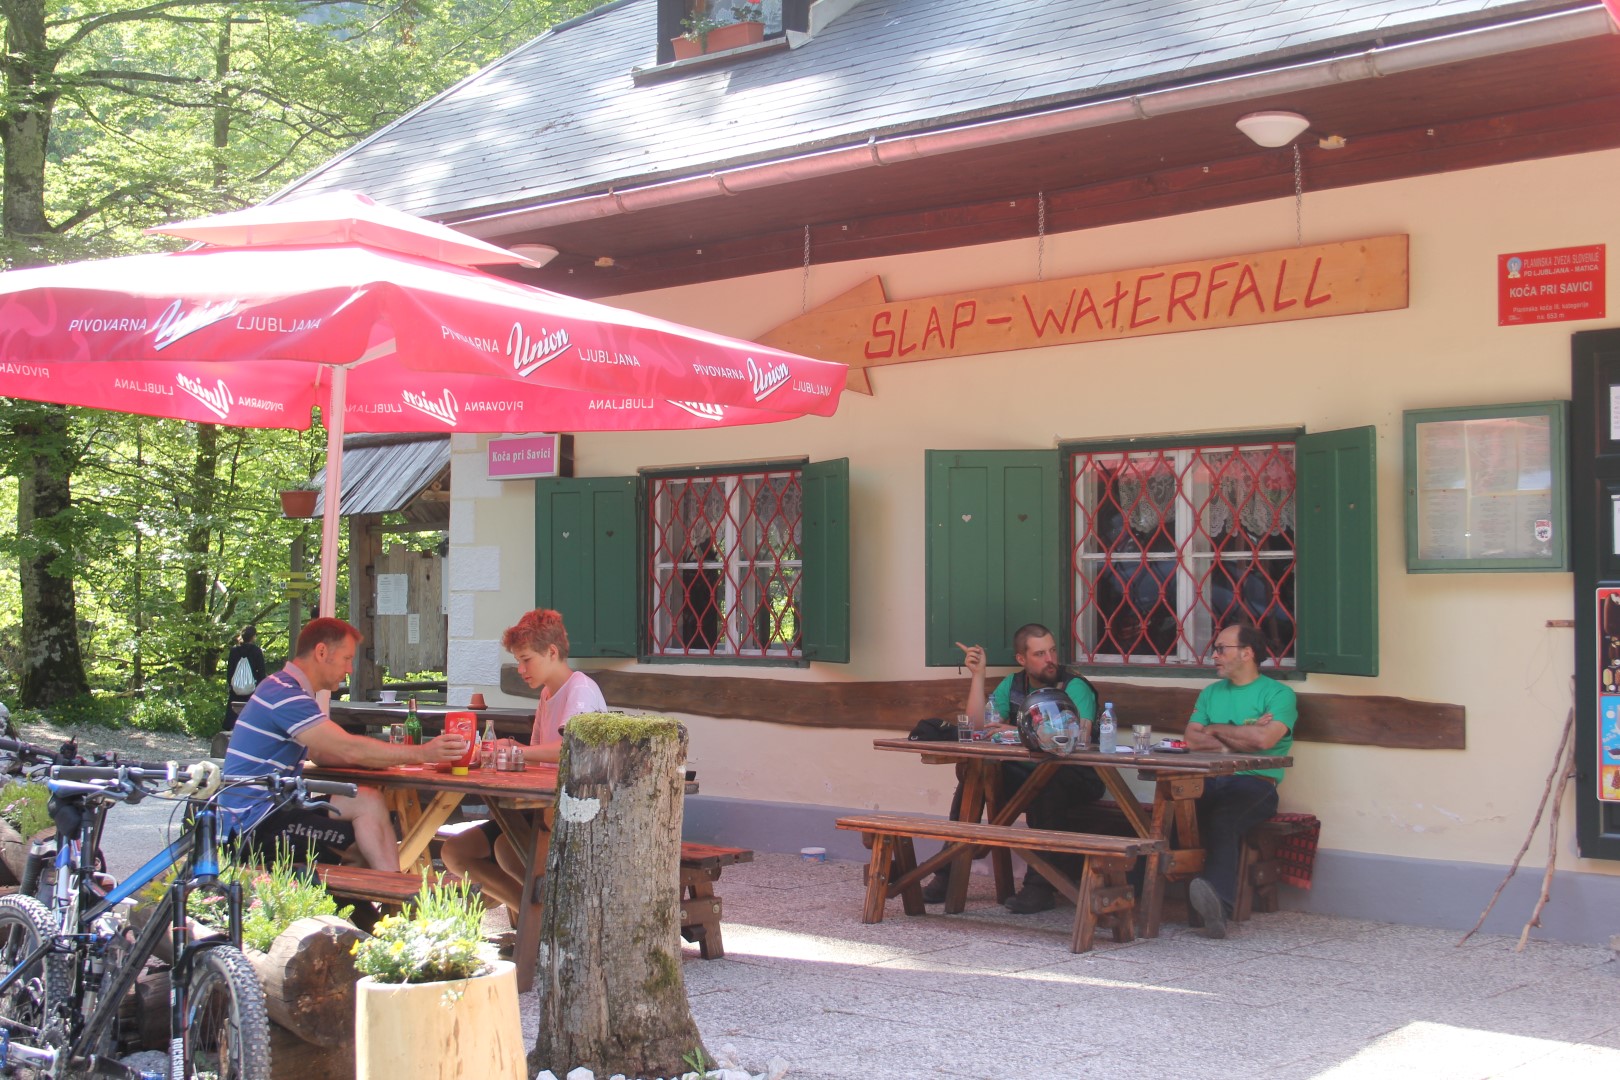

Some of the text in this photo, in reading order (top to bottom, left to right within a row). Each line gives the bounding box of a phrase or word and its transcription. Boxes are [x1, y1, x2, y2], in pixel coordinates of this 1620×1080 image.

[1533, 267, 1570, 276] LJUBLJANA
[1574, 264, 1599, 273] MATICA
[1509, 281, 1593, 298] KOČA PRI SAVICI
[68, 318, 147, 332] PIVOVARNA
[236, 316, 322, 333] LJUBLJANA
[864, 300, 977, 359] SLAP
[506, 322, 573, 377] Union
[578, 348, 641, 367] LJUBLJANA
[692, 363, 746, 381] PIVOVARNA
[746, 357, 792, 402] Union
[492, 447, 551, 463] Koča pri Savici
[286, 823, 345, 844] skinfit
